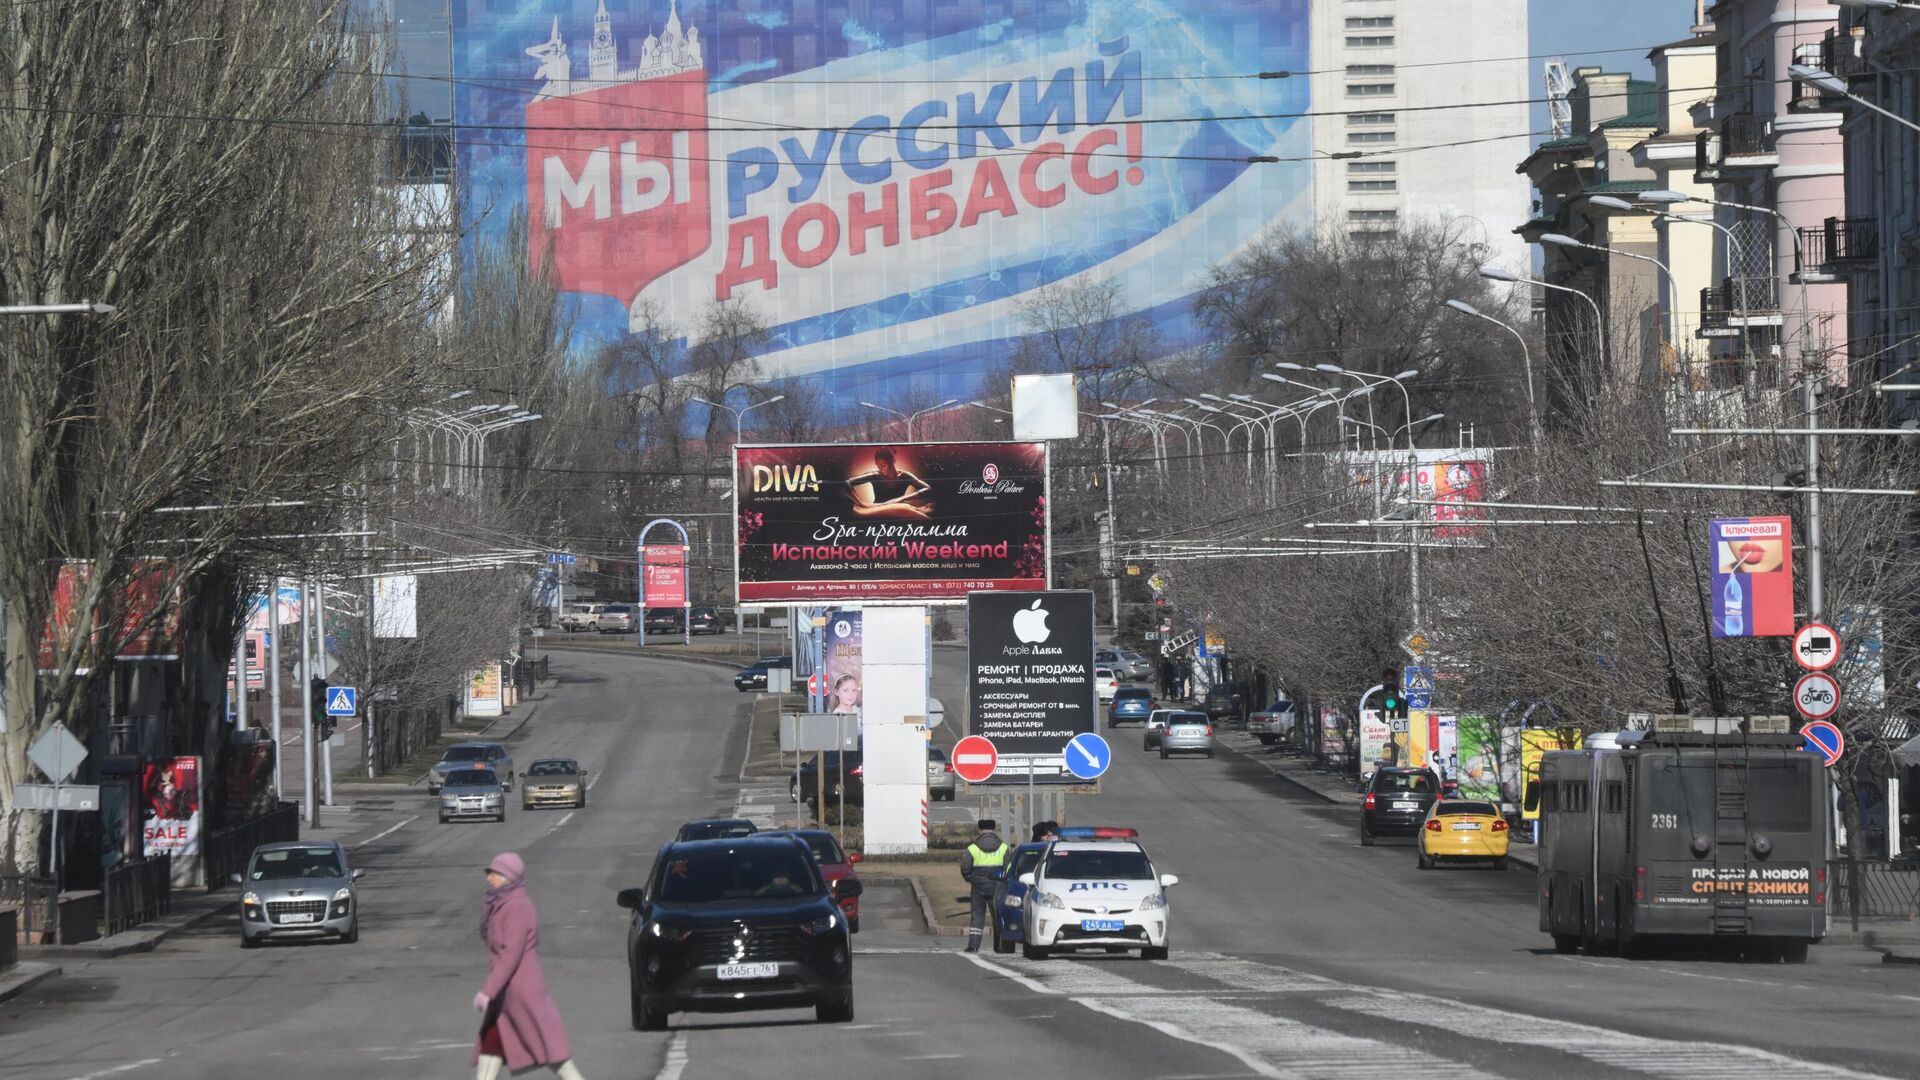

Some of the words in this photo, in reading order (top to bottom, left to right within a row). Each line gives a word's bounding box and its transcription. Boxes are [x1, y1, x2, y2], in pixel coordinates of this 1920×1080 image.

[726, 37, 1143, 219] РУССКИЙ
[542, 130, 691, 230] МЫ
[715, 121, 1145, 301] ДОНБАСС!
[753, 464, 820, 492] DIVA
[958, 480, 993, 494] Donbass
[994, 480, 1025, 494] Palace
[813, 516, 968, 547] Spa-программа
[772, 541, 898, 561] Испанский
[904, 540, 1008, 560] Weekend
[874, 562, 911, 570] Испанский
[1002, 645, 1030, 656] Apple
[1031, 645, 1063, 655] Лавка
[977, 665, 1021, 675] РЕМОНТ
[1031, 664, 1086, 675] ПРОДАЖА
[978, 676, 1004, 685] iPhone,
[1005, 676, 1023, 685] iPad,
[1024, 676, 1059, 685] MacBook,
[1393, 720, 1408, 730] СТ
[983, 730, 1037, 738] ОФИЦИАЛЬНАЯ
[1651, 814, 1677, 829] 2361
[144, 827, 188, 839] SALE
[1762, 867, 1809, 880] НОВОЙ
[1069, 881, 1129, 893] ДПС
